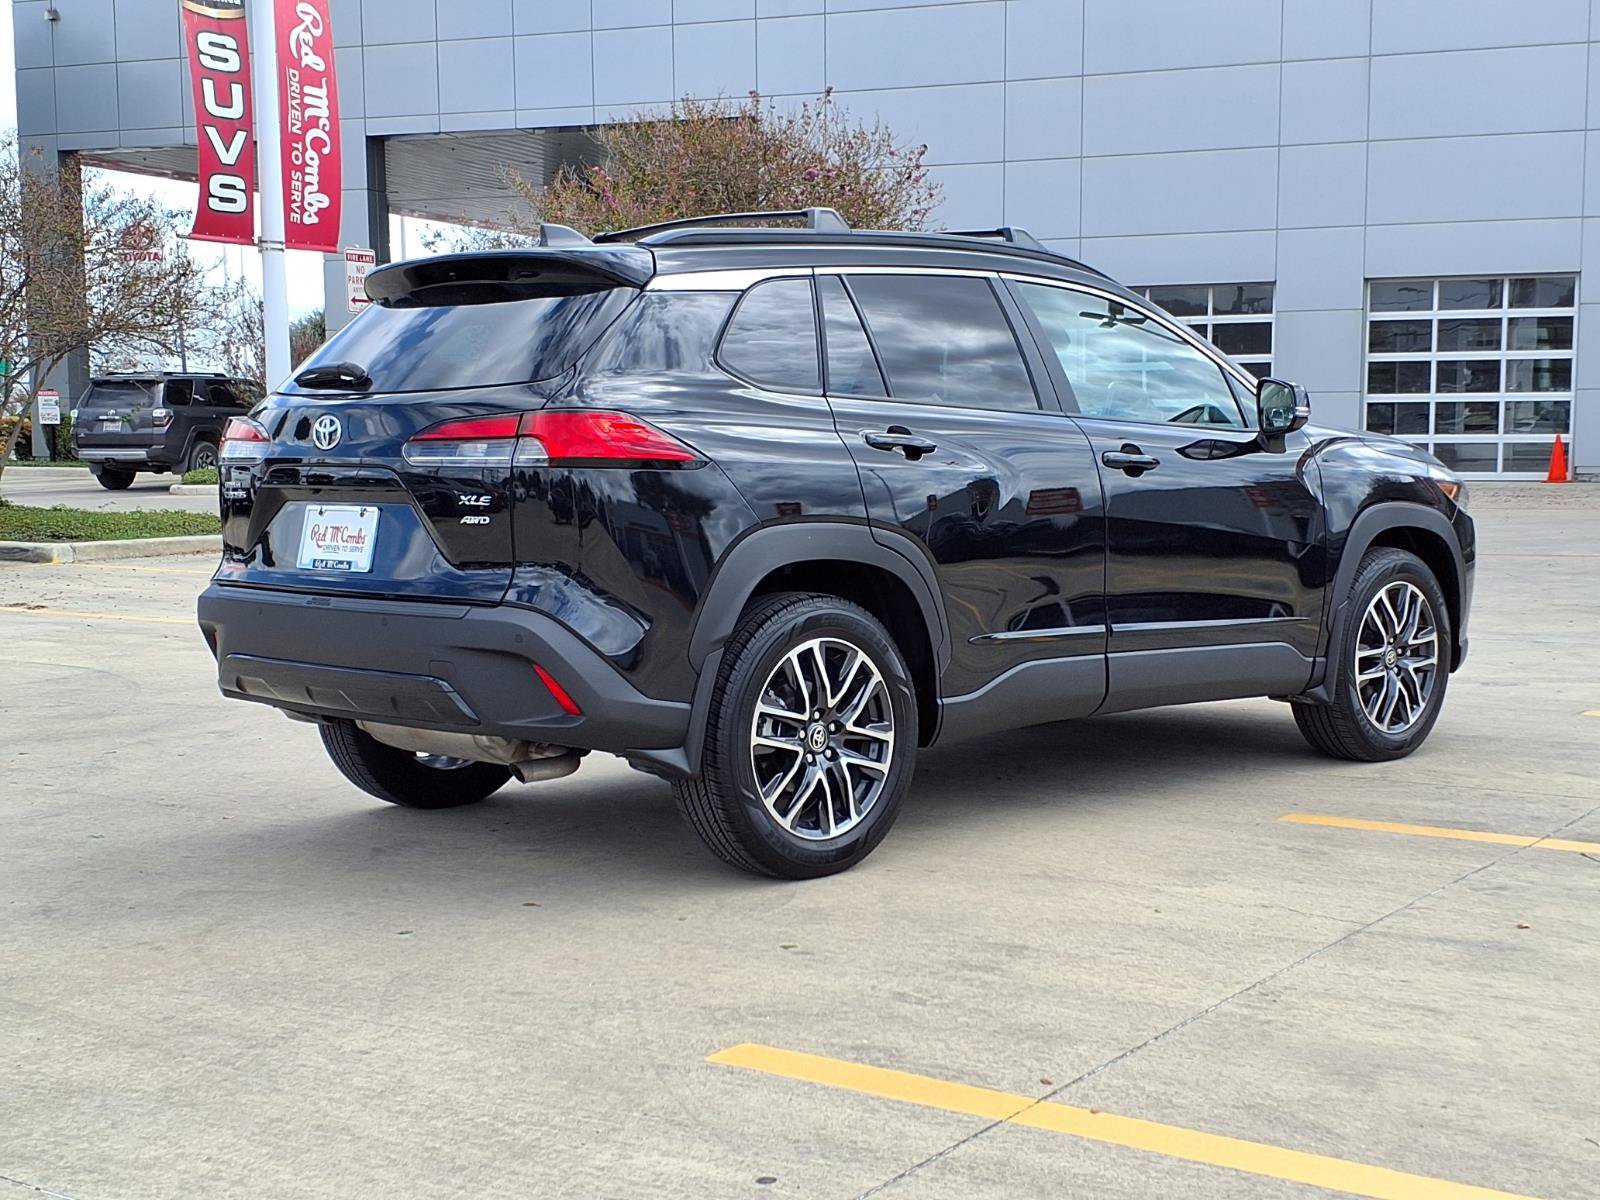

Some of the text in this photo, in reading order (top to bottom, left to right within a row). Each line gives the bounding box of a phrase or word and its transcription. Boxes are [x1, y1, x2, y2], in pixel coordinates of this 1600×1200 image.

[289, 2, 331, 225] Red McCombs
[196, 31, 248, 214] SUVS
[288, 67, 303, 224] DRIVEN TO SERVE
[356, 265, 365, 275] NO
[348, 276, 364, 285] PARK
[458, 495, 492, 506] XLE
[460, 515, 491, 525] AWD
[311, 524, 367, 548] Red McCombs
[322, 544, 340, 552] DRIVEN
[315, 559, 326, 568] Rd
